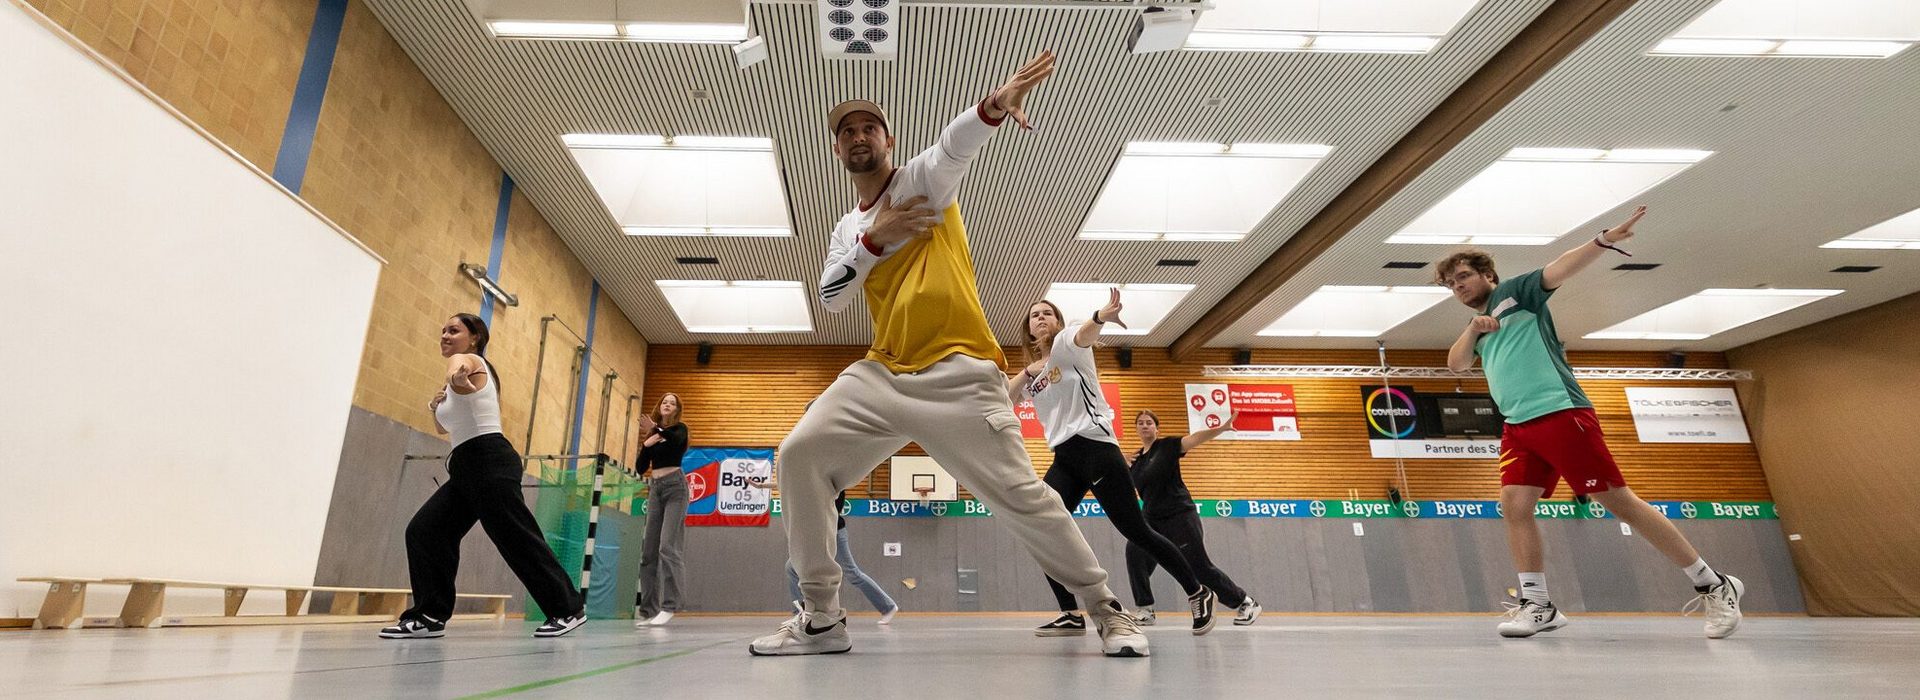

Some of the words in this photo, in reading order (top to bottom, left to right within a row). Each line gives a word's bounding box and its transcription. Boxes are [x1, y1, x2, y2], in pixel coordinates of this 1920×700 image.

[1425, 444, 1464, 454] Partner
[1468, 444, 1487, 454] des
[738, 462, 755, 474] SC
[735, 490, 752, 502] 05
[720, 502, 766, 512] Uerdingen
[869, 499, 918, 516] Bayer
[1248, 500, 1297, 517] Bayer
[1341, 501, 1391, 517] Bayer
[1435, 501, 1483, 517] Bayer
[1711, 502, 1760, 518] Bayer
